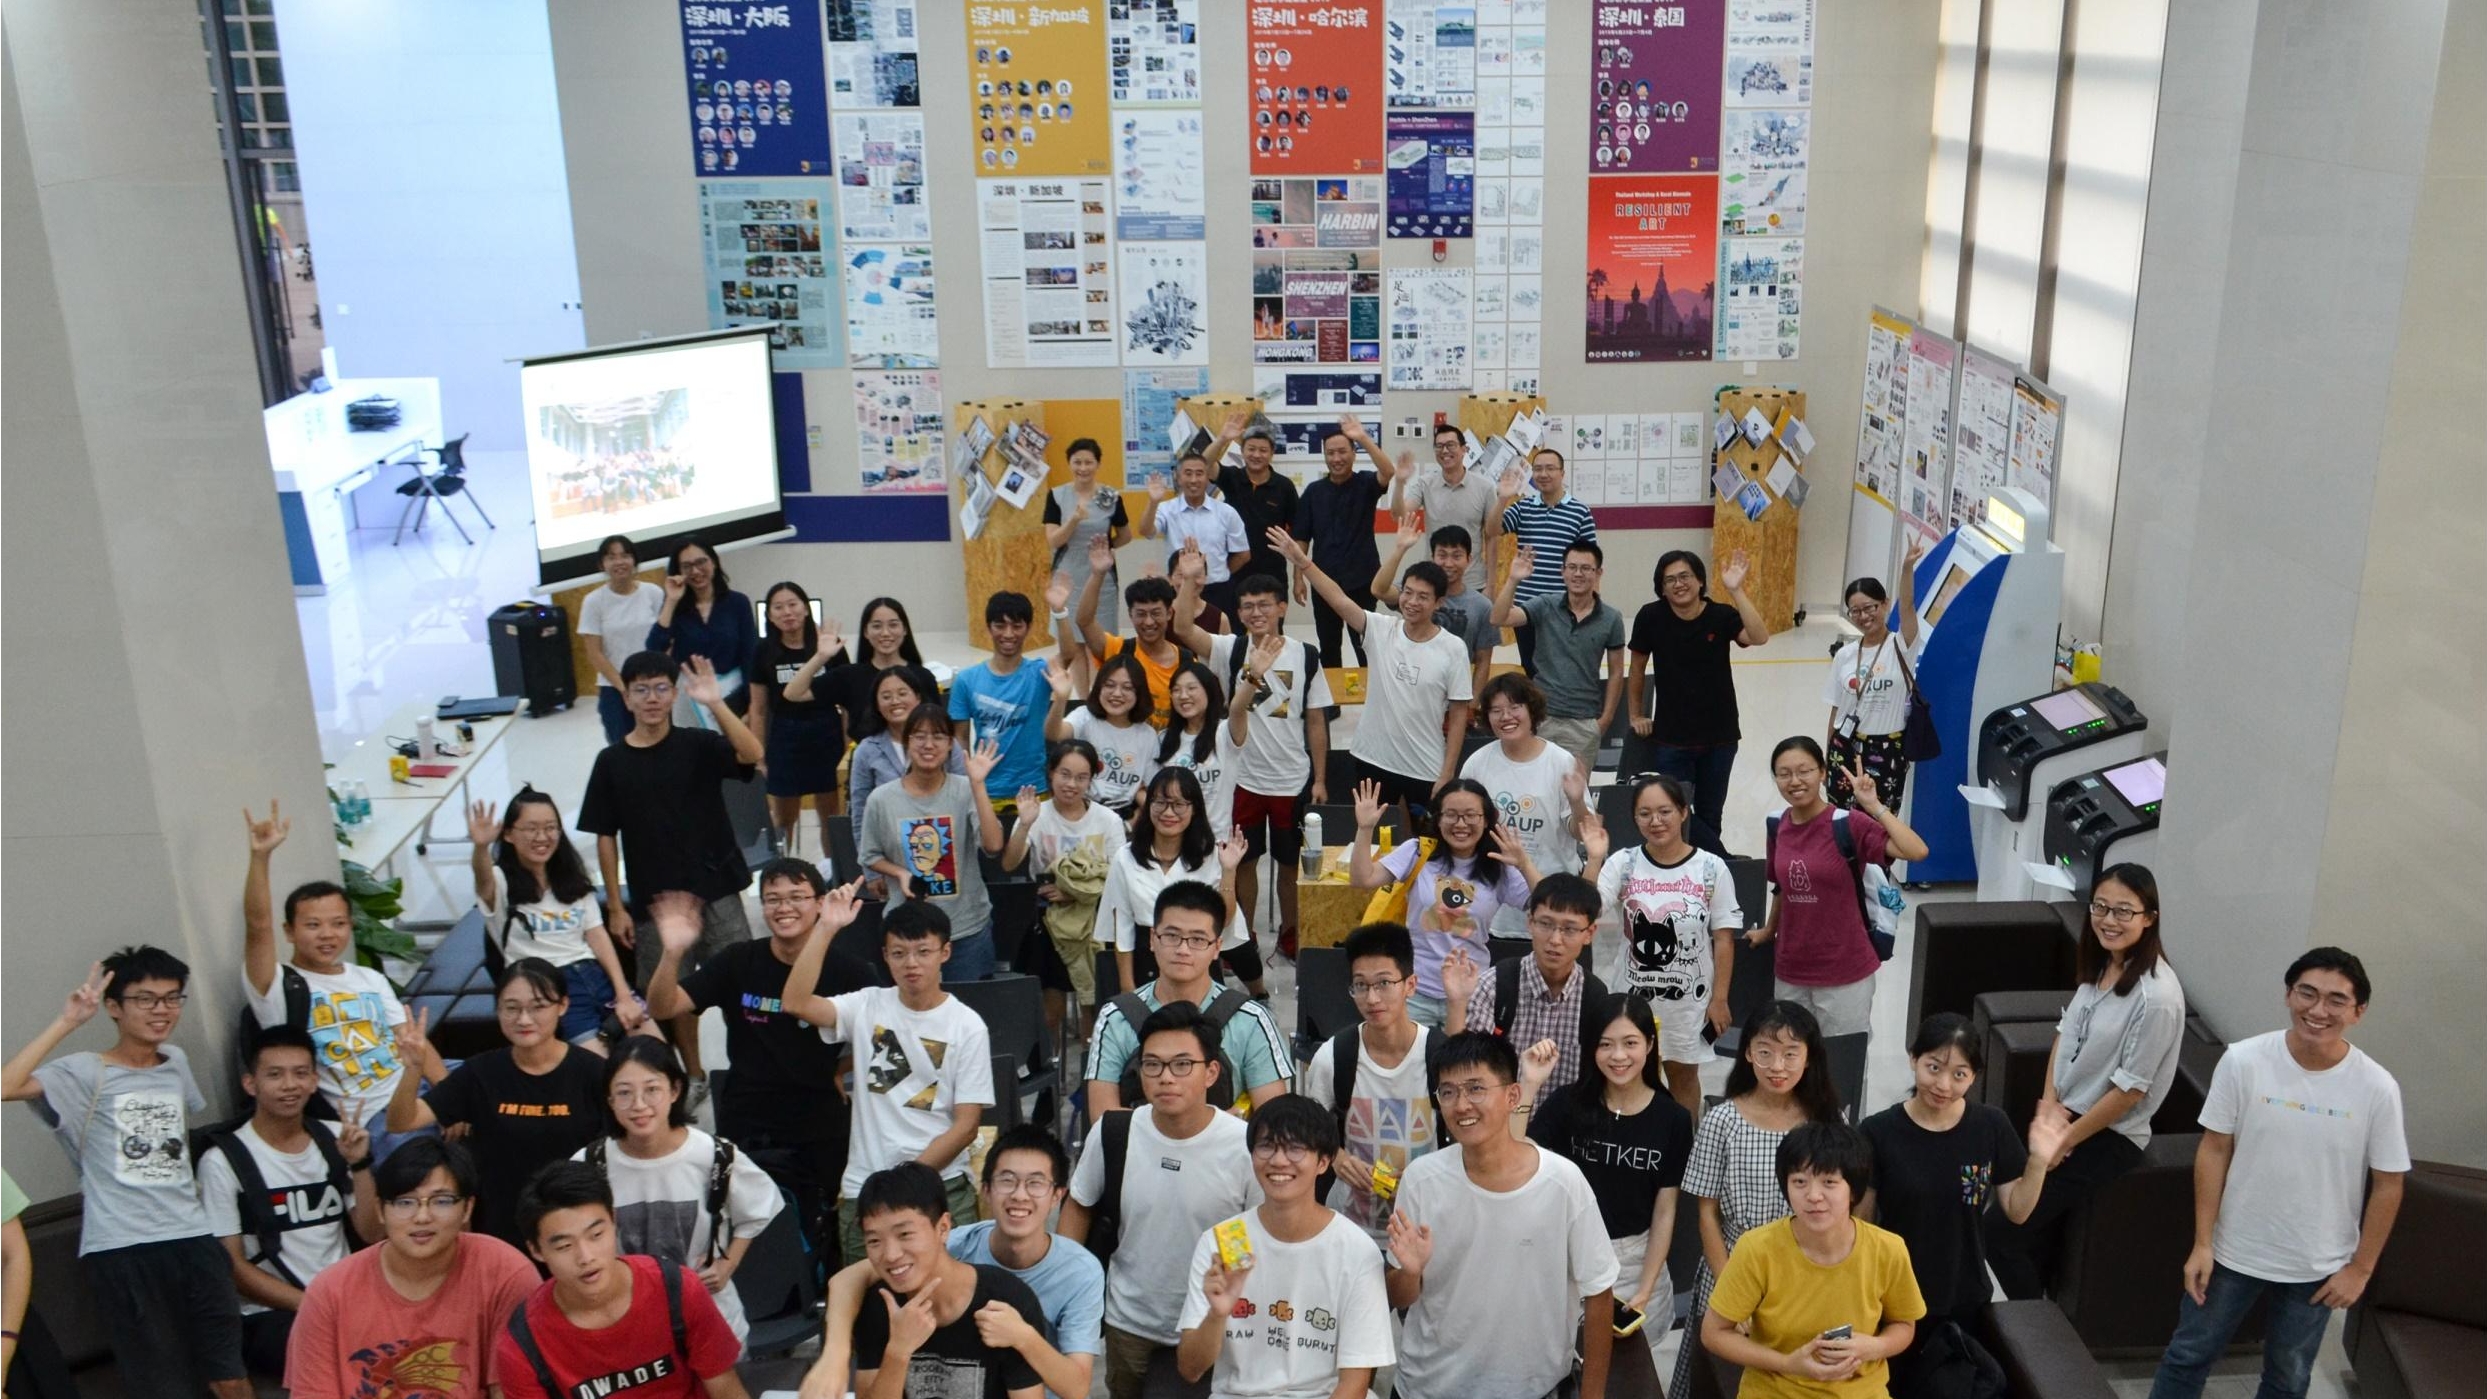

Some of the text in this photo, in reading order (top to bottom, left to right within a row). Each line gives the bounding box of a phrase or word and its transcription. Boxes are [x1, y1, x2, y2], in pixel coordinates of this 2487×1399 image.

[1598, 7, 1685, 28] 深圳·泰国
[1615, 203, 1692, 217] RESILIENT
[1318, 212, 1379, 230] HARBIN
[1639, 217, 1667, 230] ART
[1286, 281, 1348, 296] SHENZHEN
[1257, 347, 1314, 358] HONGKONG
[1107, 770, 1140, 786] AUP
[1506, 816, 1544, 833] AUP
[271, 1184, 344, 1224] FILA
[1226, 1330, 1254, 1339] RAW
[1297, 1337, 1336, 1354] BURNT
